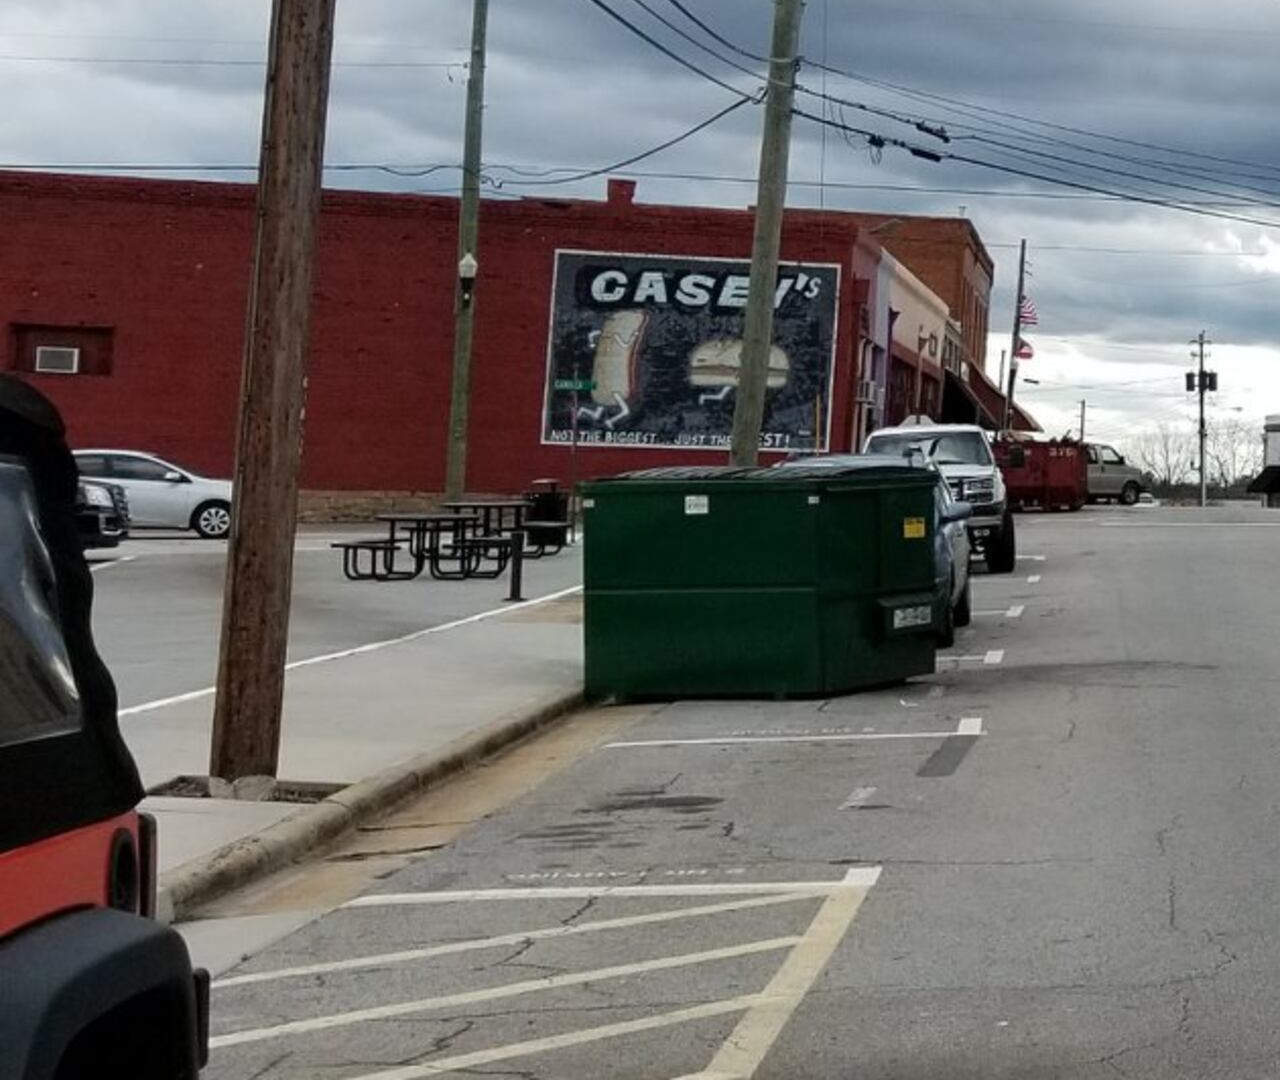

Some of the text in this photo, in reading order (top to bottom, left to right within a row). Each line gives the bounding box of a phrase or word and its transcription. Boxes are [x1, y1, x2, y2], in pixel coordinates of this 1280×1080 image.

[551, 429, 574, 441] NOT
[579, 431, 602, 443] THE
[674, 433, 705, 445] JUST
[758, 432, 790, 449] EST!
